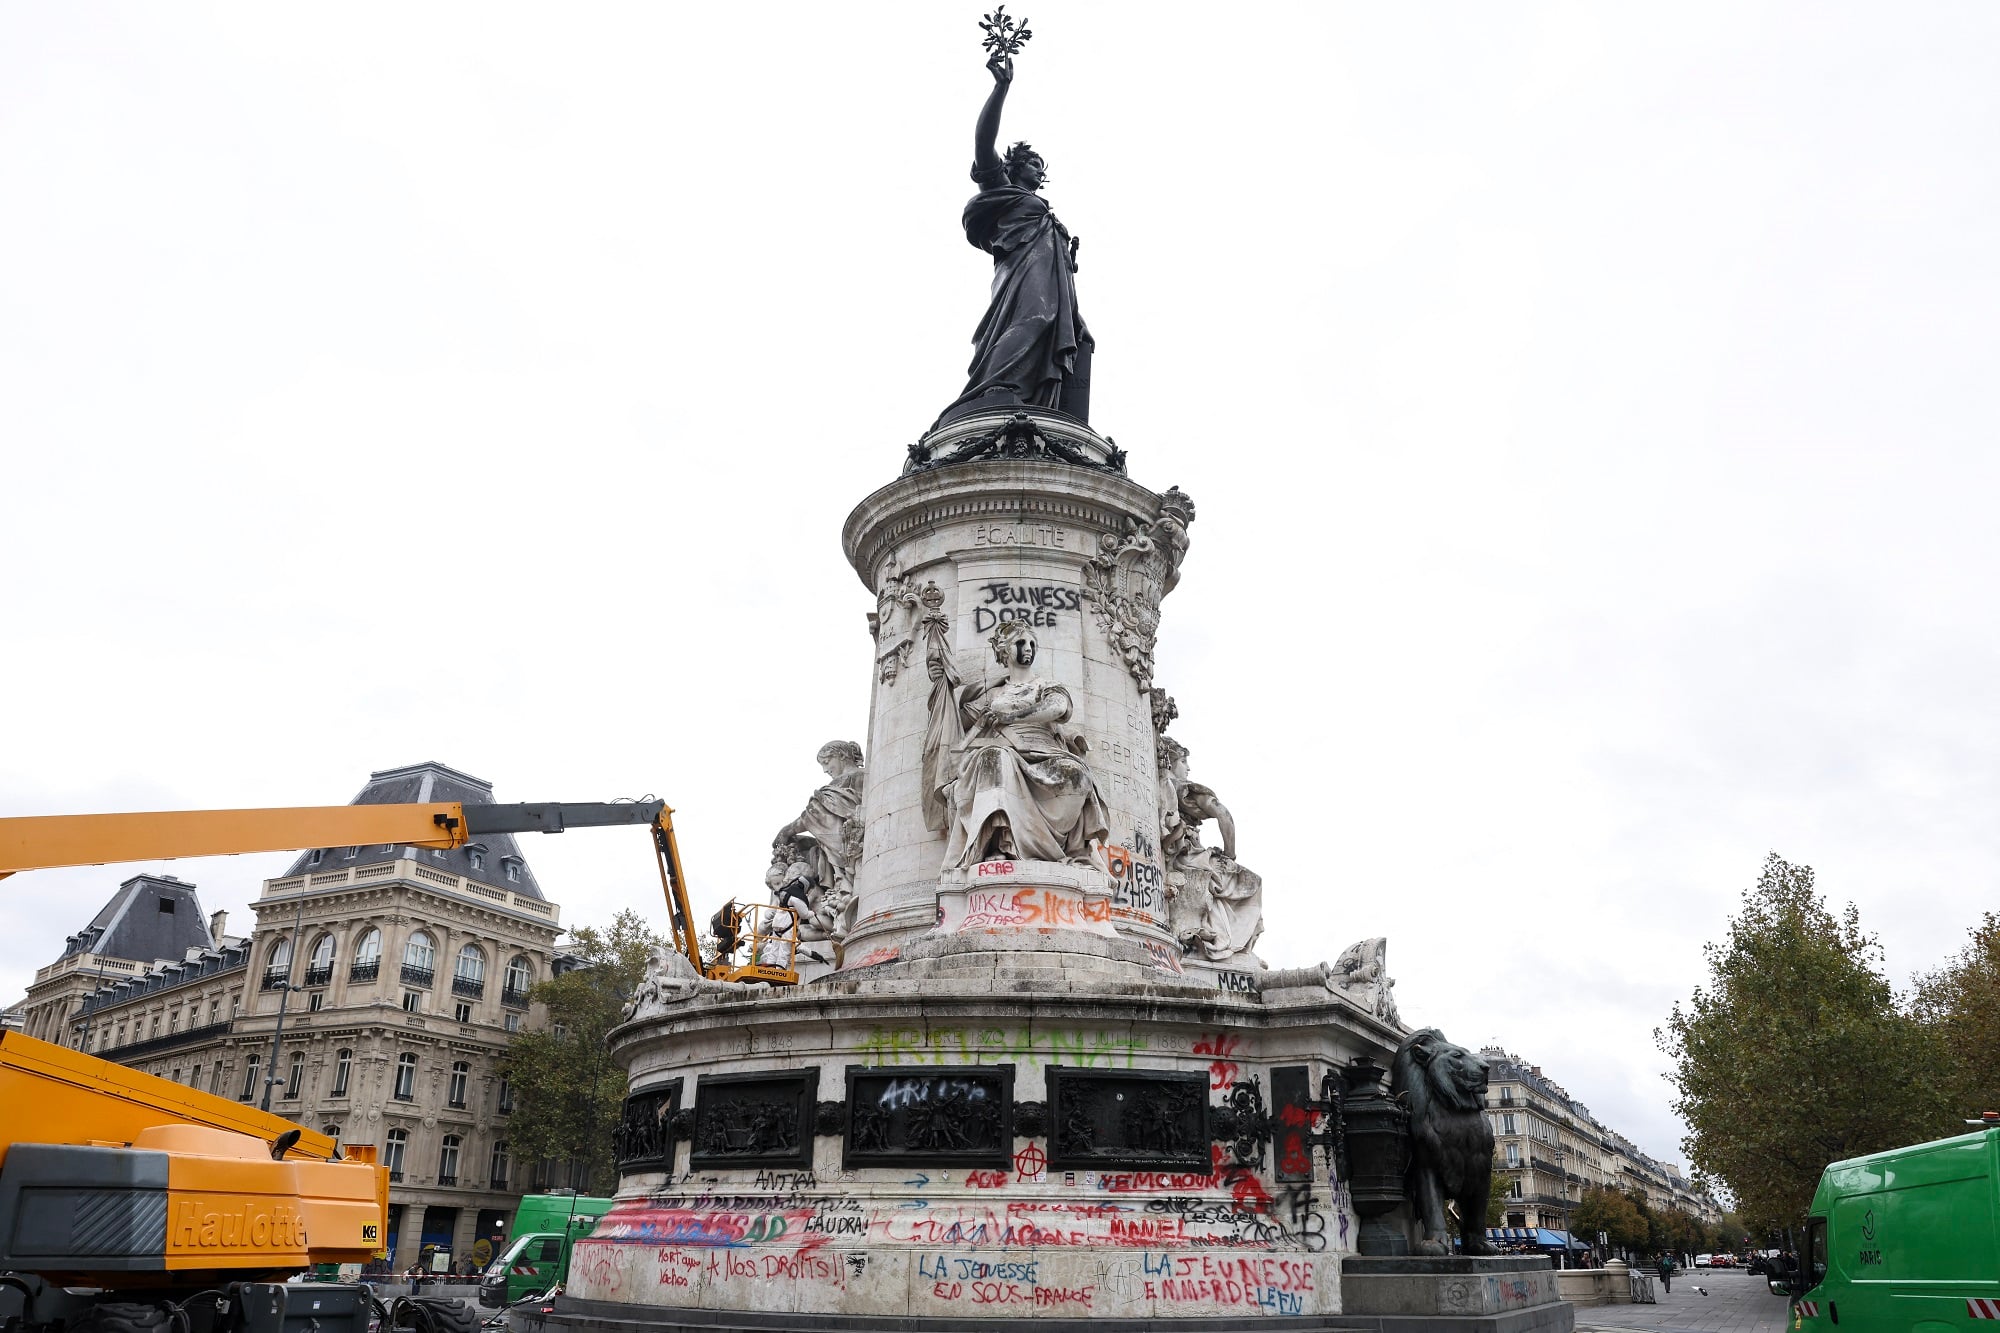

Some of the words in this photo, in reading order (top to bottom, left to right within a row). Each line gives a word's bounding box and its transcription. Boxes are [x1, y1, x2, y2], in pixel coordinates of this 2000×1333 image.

[972, 606, 1057, 634] DORÉE
[978, 861, 1014, 877] ACAB
[968, 893, 997, 914] NIK
[766, 1033, 793, 1050] 1848
[872, 1030, 961, 1044] SEPTEMBRE
[971, 1030, 1004, 1044] 1870
[1089, 1031, 1151, 1049] JUILLET
[1156, 1034, 1188, 1050] 1880
[172, 1202, 308, 1248] Haulotte
[1859, 1249, 1882, 1265] PARIS
[919, 1254, 948, 1279] LA
[954, 1258, 1039, 1283] JEUNESSE
[1144, 1251, 1171, 1278] LA
[1175, 1256, 1314, 1291] JEUNESSE
[933, 1281, 963, 1300] EN
[1093, 1259, 1145, 1305] ACAB
[1144, 1278, 1258, 1307] EMMERDE
[1257, 1286, 1276, 1307] LE
[1278, 1292, 1303, 1314] FN
